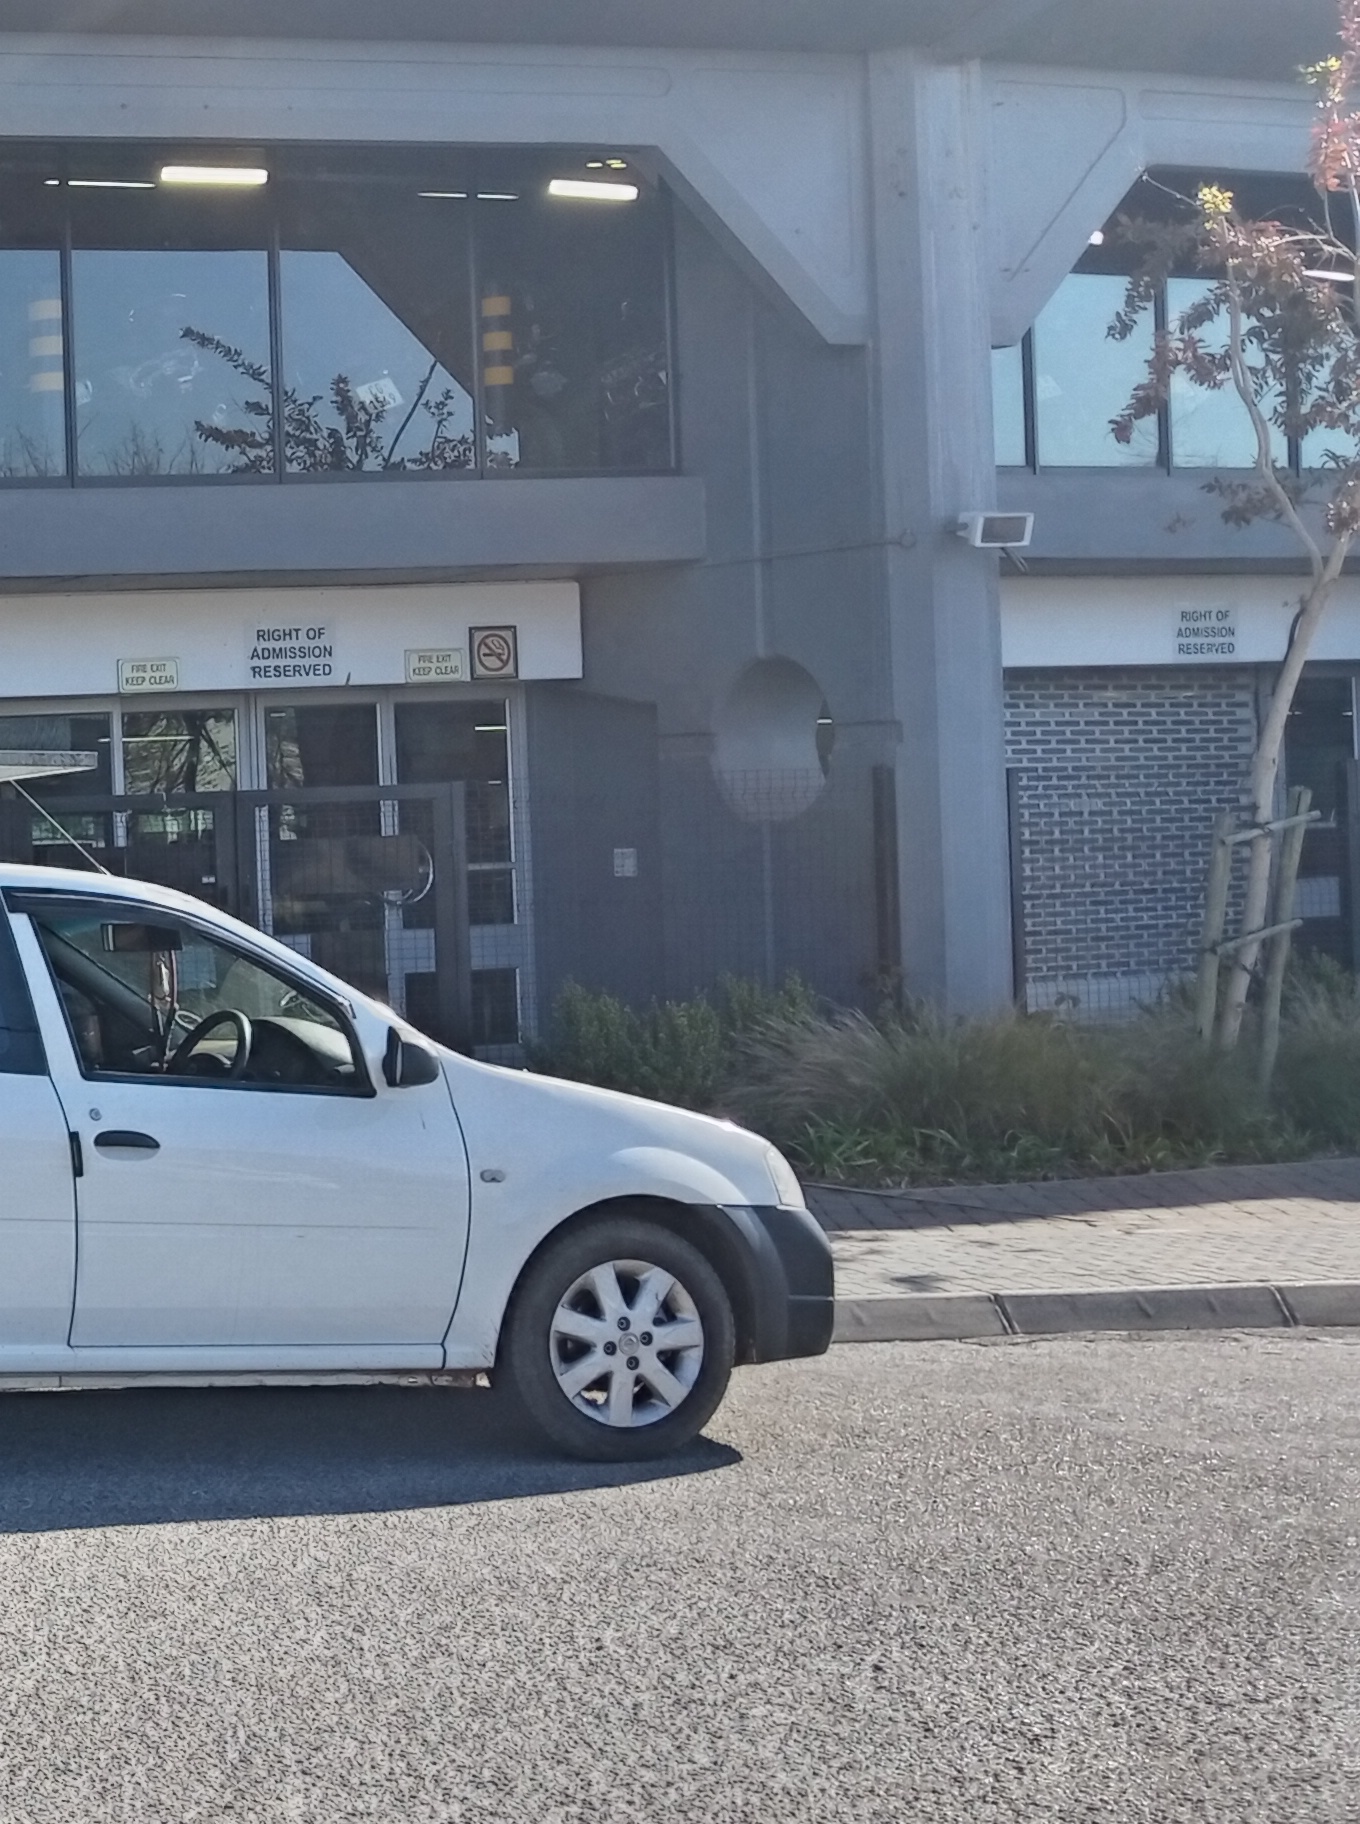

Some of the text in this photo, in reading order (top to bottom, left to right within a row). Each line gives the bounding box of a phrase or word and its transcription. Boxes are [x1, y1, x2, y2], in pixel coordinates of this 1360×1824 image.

[1181, 610, 1230, 622] RIGHT OF
[256, 627, 325, 642] RIGHT OF
[1176, 627, 1235, 638] ADMISSION
[250, 645, 332, 660] ADMISSION
[1178, 642, 1235, 654] RESERVED
[131, 663, 167, 673] FIRE EXIT
[251, 663, 332, 678] RESERVED
[434, 665, 459, 675] CLEAR
[125, 675, 175, 686] KEEP CLEAR
